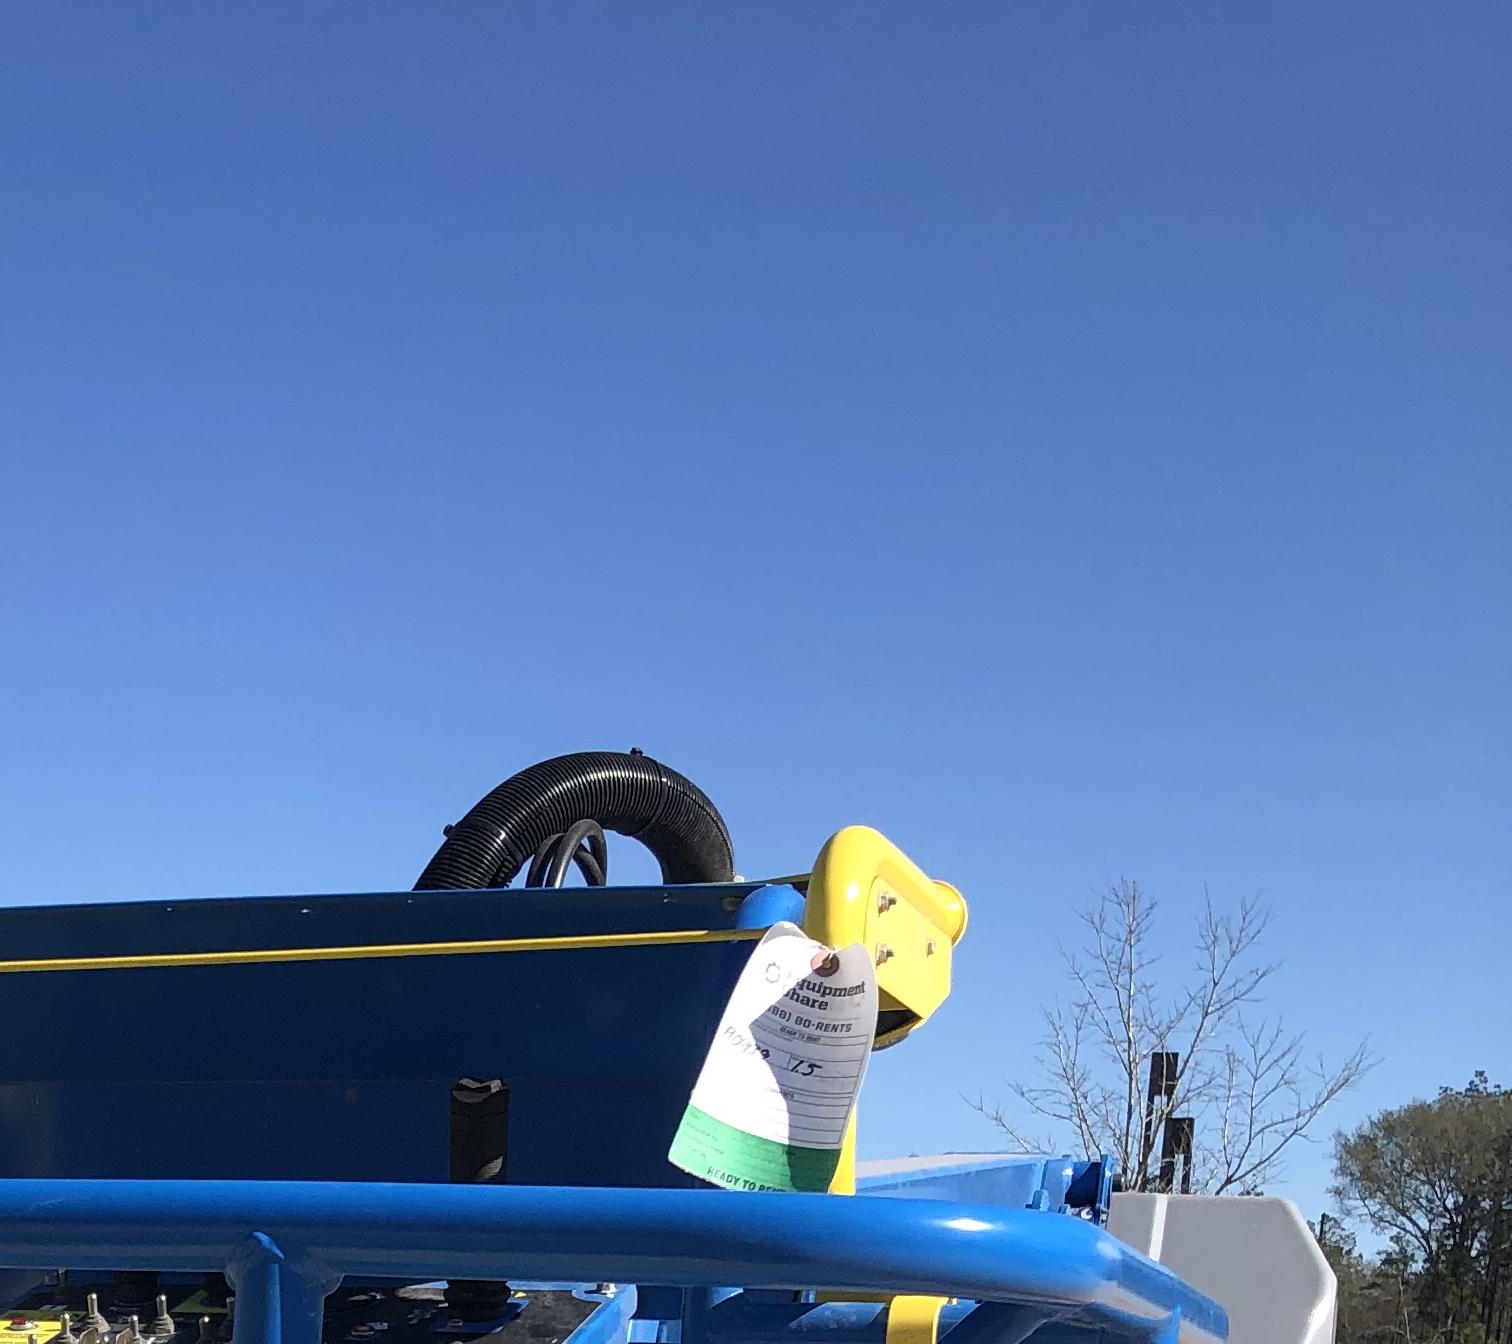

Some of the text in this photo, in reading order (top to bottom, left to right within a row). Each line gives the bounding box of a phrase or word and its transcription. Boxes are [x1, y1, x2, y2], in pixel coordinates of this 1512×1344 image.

[788, 972, 865, 998] quipment
[783, 986, 829, 1010] hare
[794, 1016, 852, 1033] 80-RENTS
[708, 1166, 740, 1184] READY
[742, 1179, 756, 1190] TO
